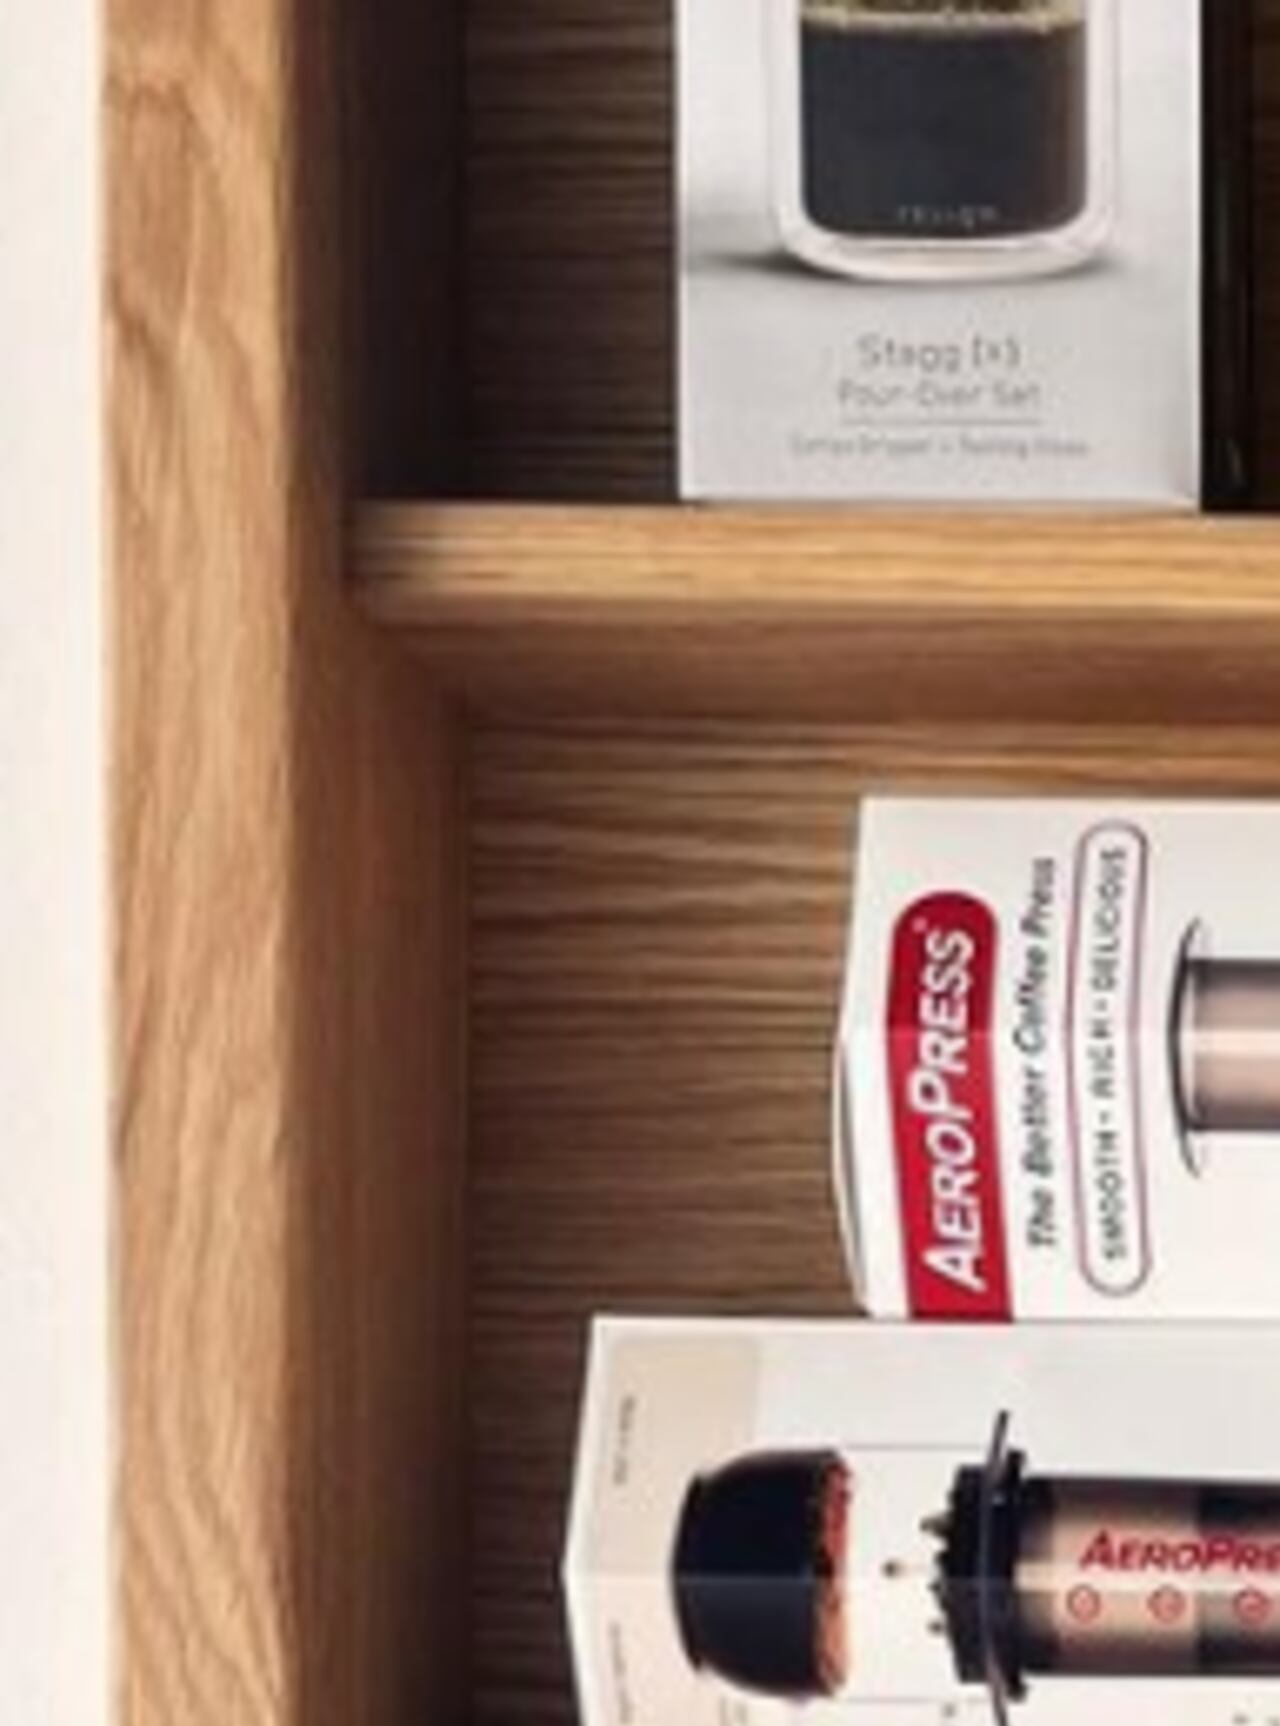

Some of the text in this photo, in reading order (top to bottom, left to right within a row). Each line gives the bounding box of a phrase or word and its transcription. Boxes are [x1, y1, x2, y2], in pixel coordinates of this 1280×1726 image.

[1013, 855, 1057, 1250] The Better Coffee Press
[1088, 847, 1128, 1262] SMOOTH RICH DELICIOUS
